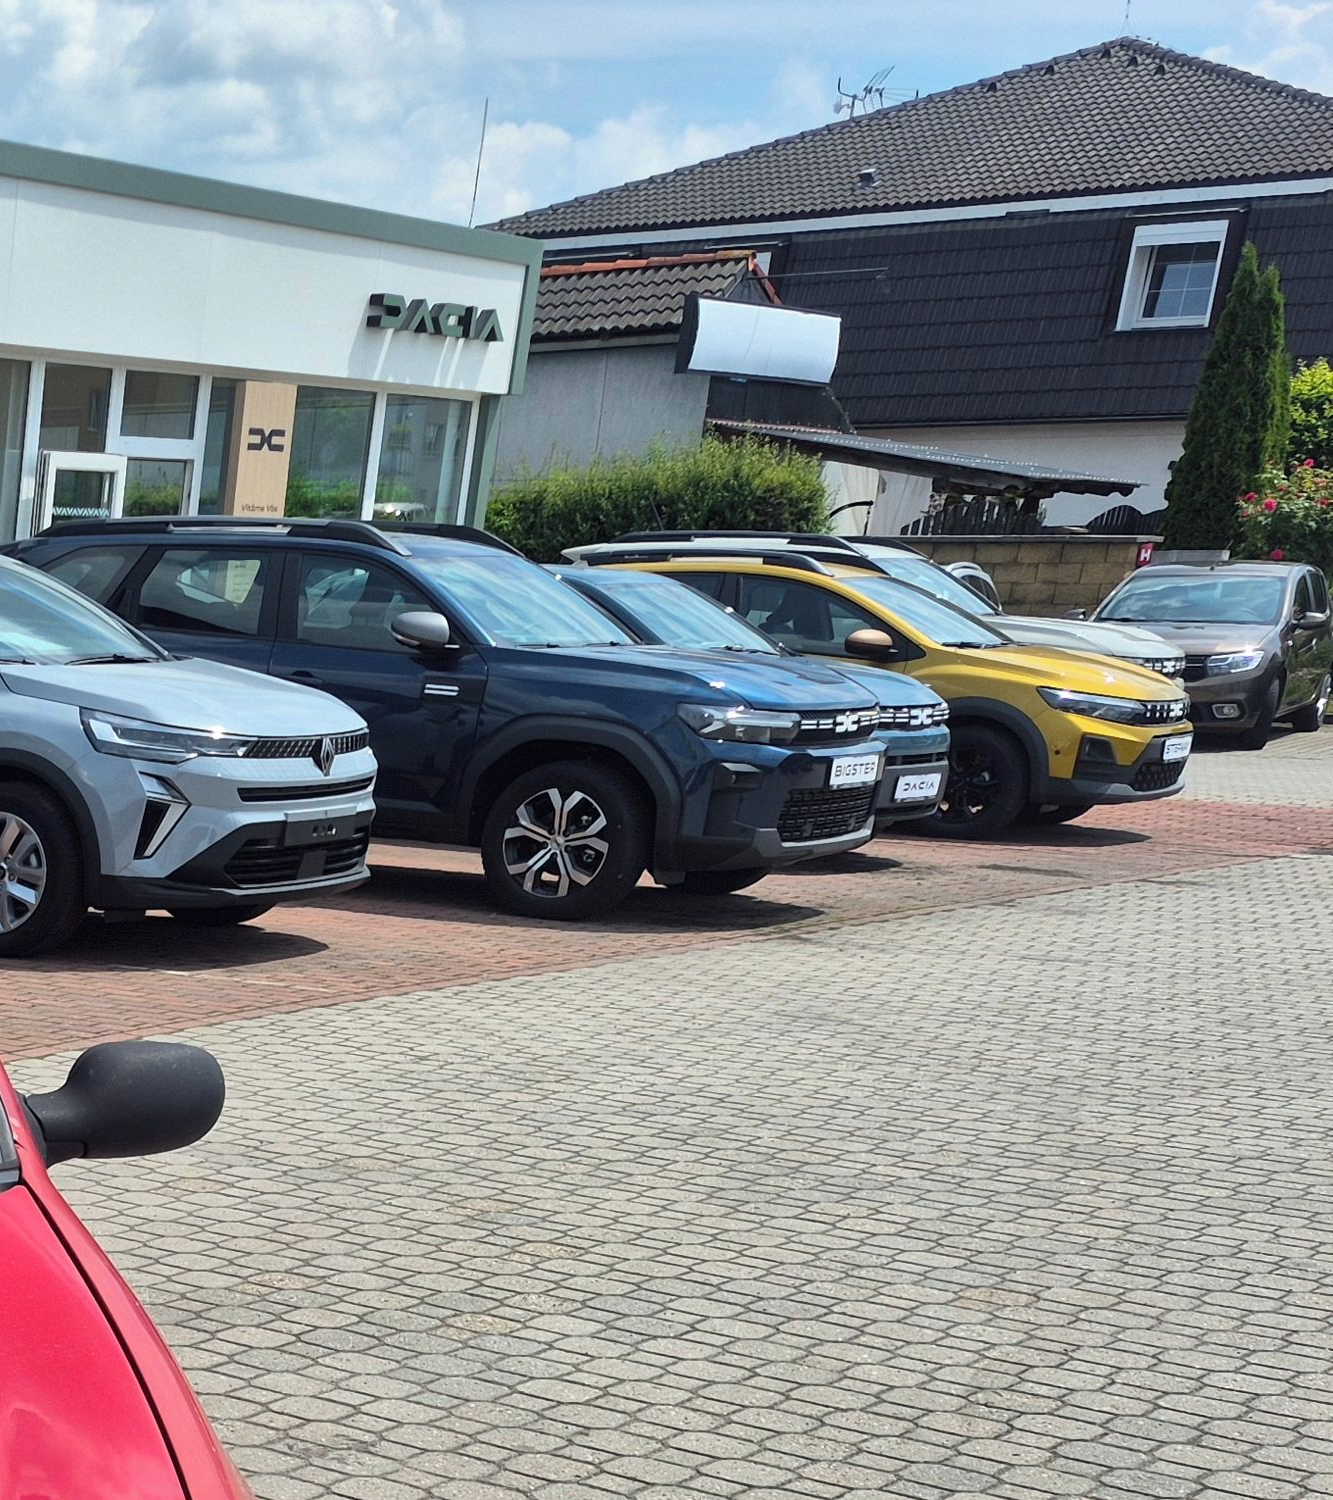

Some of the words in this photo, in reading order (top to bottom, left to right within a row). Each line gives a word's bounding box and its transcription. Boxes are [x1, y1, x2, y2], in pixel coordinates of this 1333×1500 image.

[366, 293, 504, 342] DACIA
[1140, 549, 1151, 561] H
[902, 781, 934, 792] DACIA
